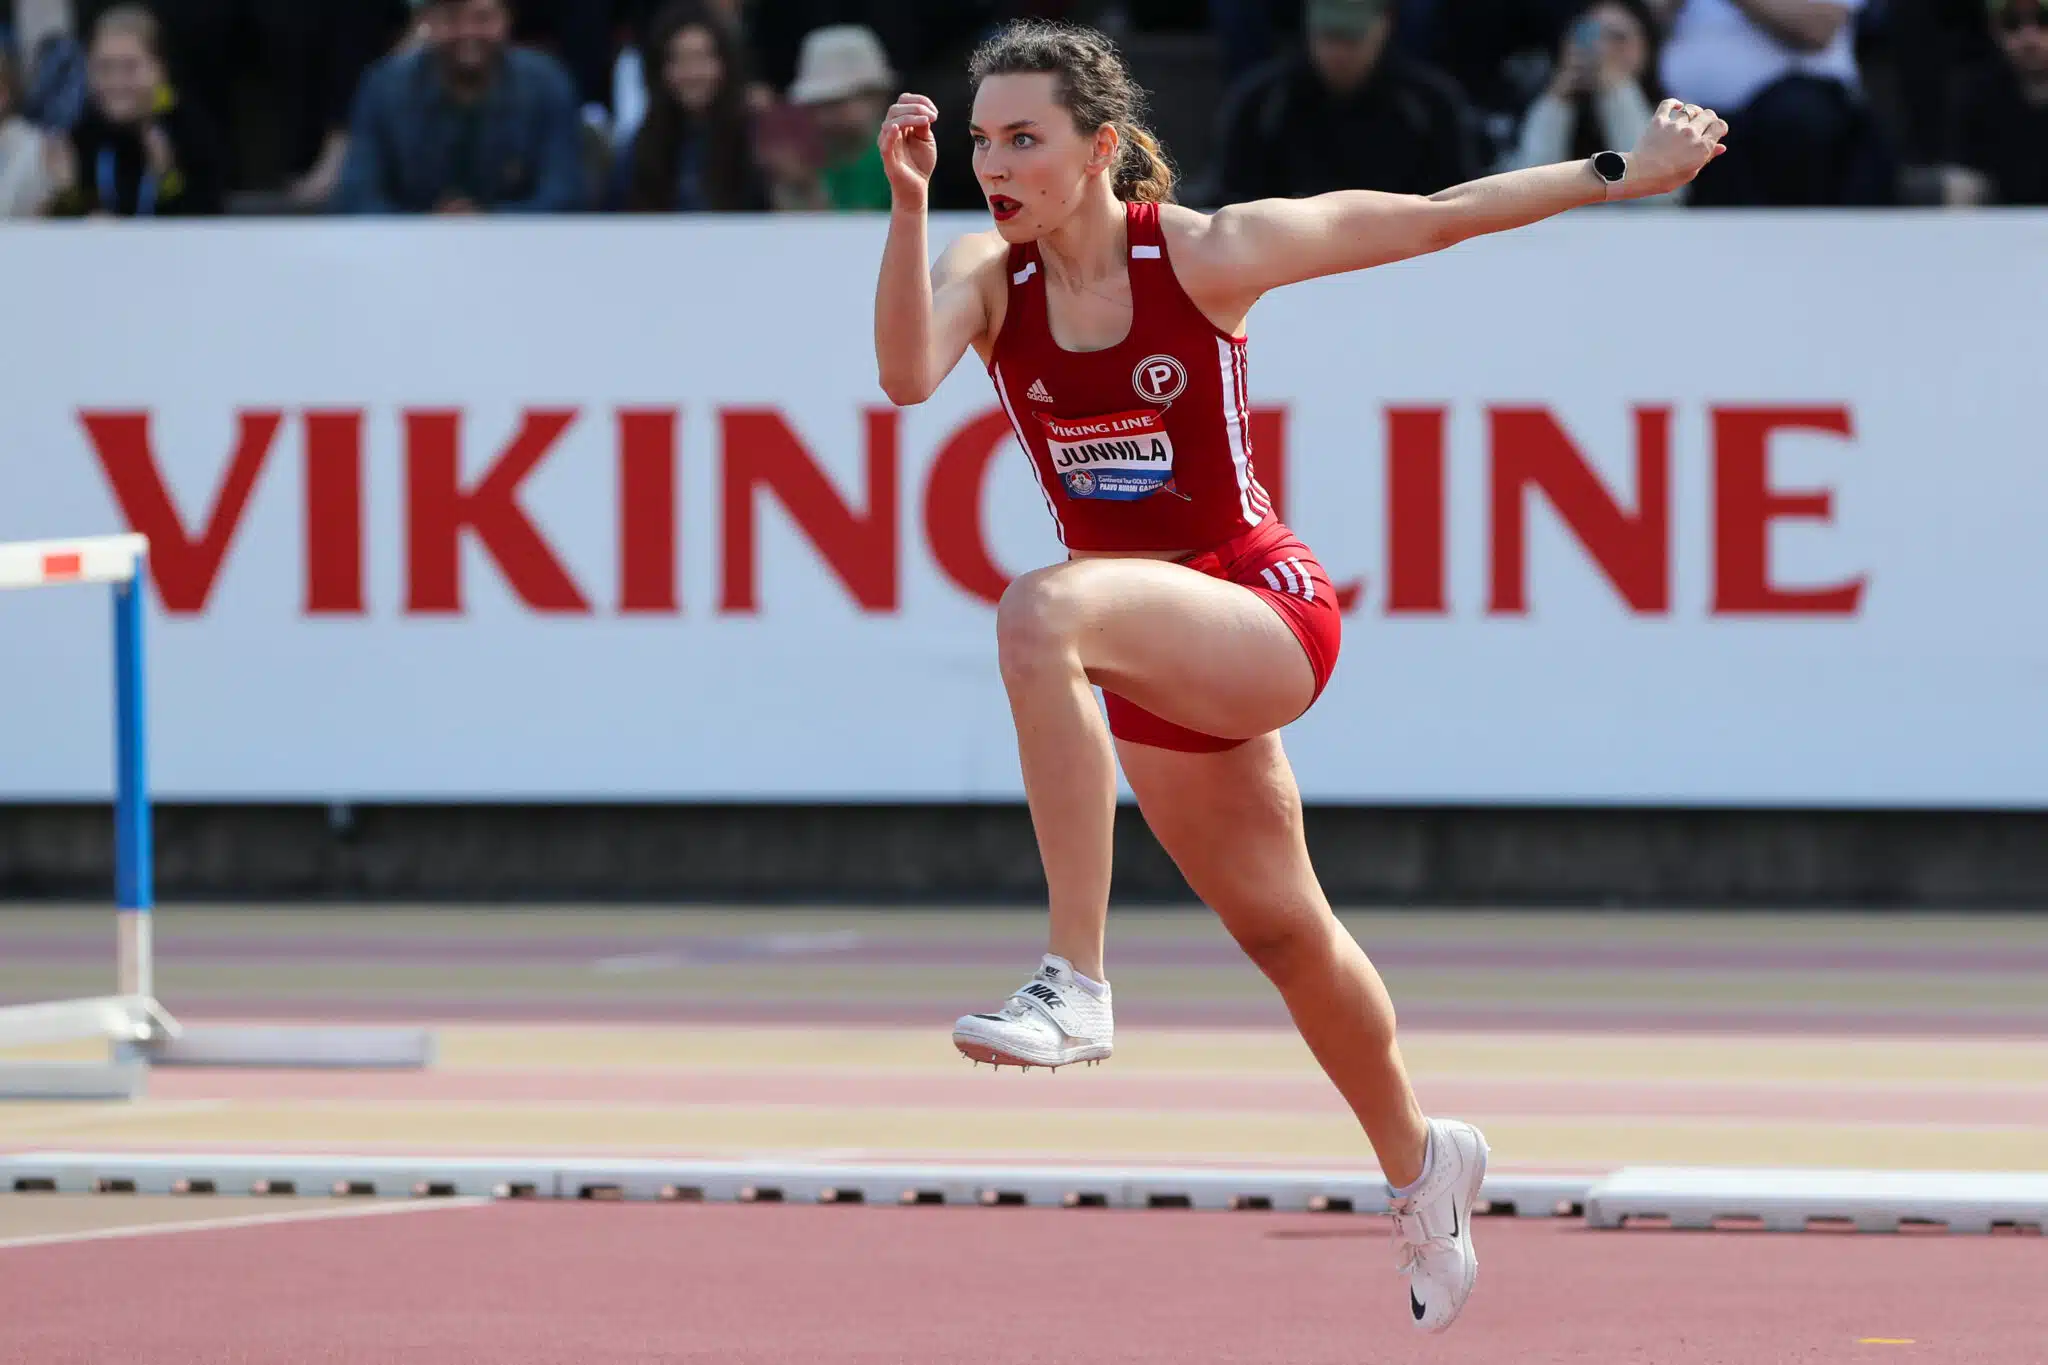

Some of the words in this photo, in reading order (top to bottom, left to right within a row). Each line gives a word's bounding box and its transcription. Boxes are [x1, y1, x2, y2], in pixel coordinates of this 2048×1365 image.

[1147, 364, 1172, 394] P
[1026, 392, 1054, 403] adidas
[1051, 423, 1110, 437] VIKING
[1112, 415, 1154, 431] LINE
[1057, 438, 1167, 467] JUNNILA
[1099, 483, 1118, 491] PAAVO
[1022, 983, 1067, 1010] NIKE
